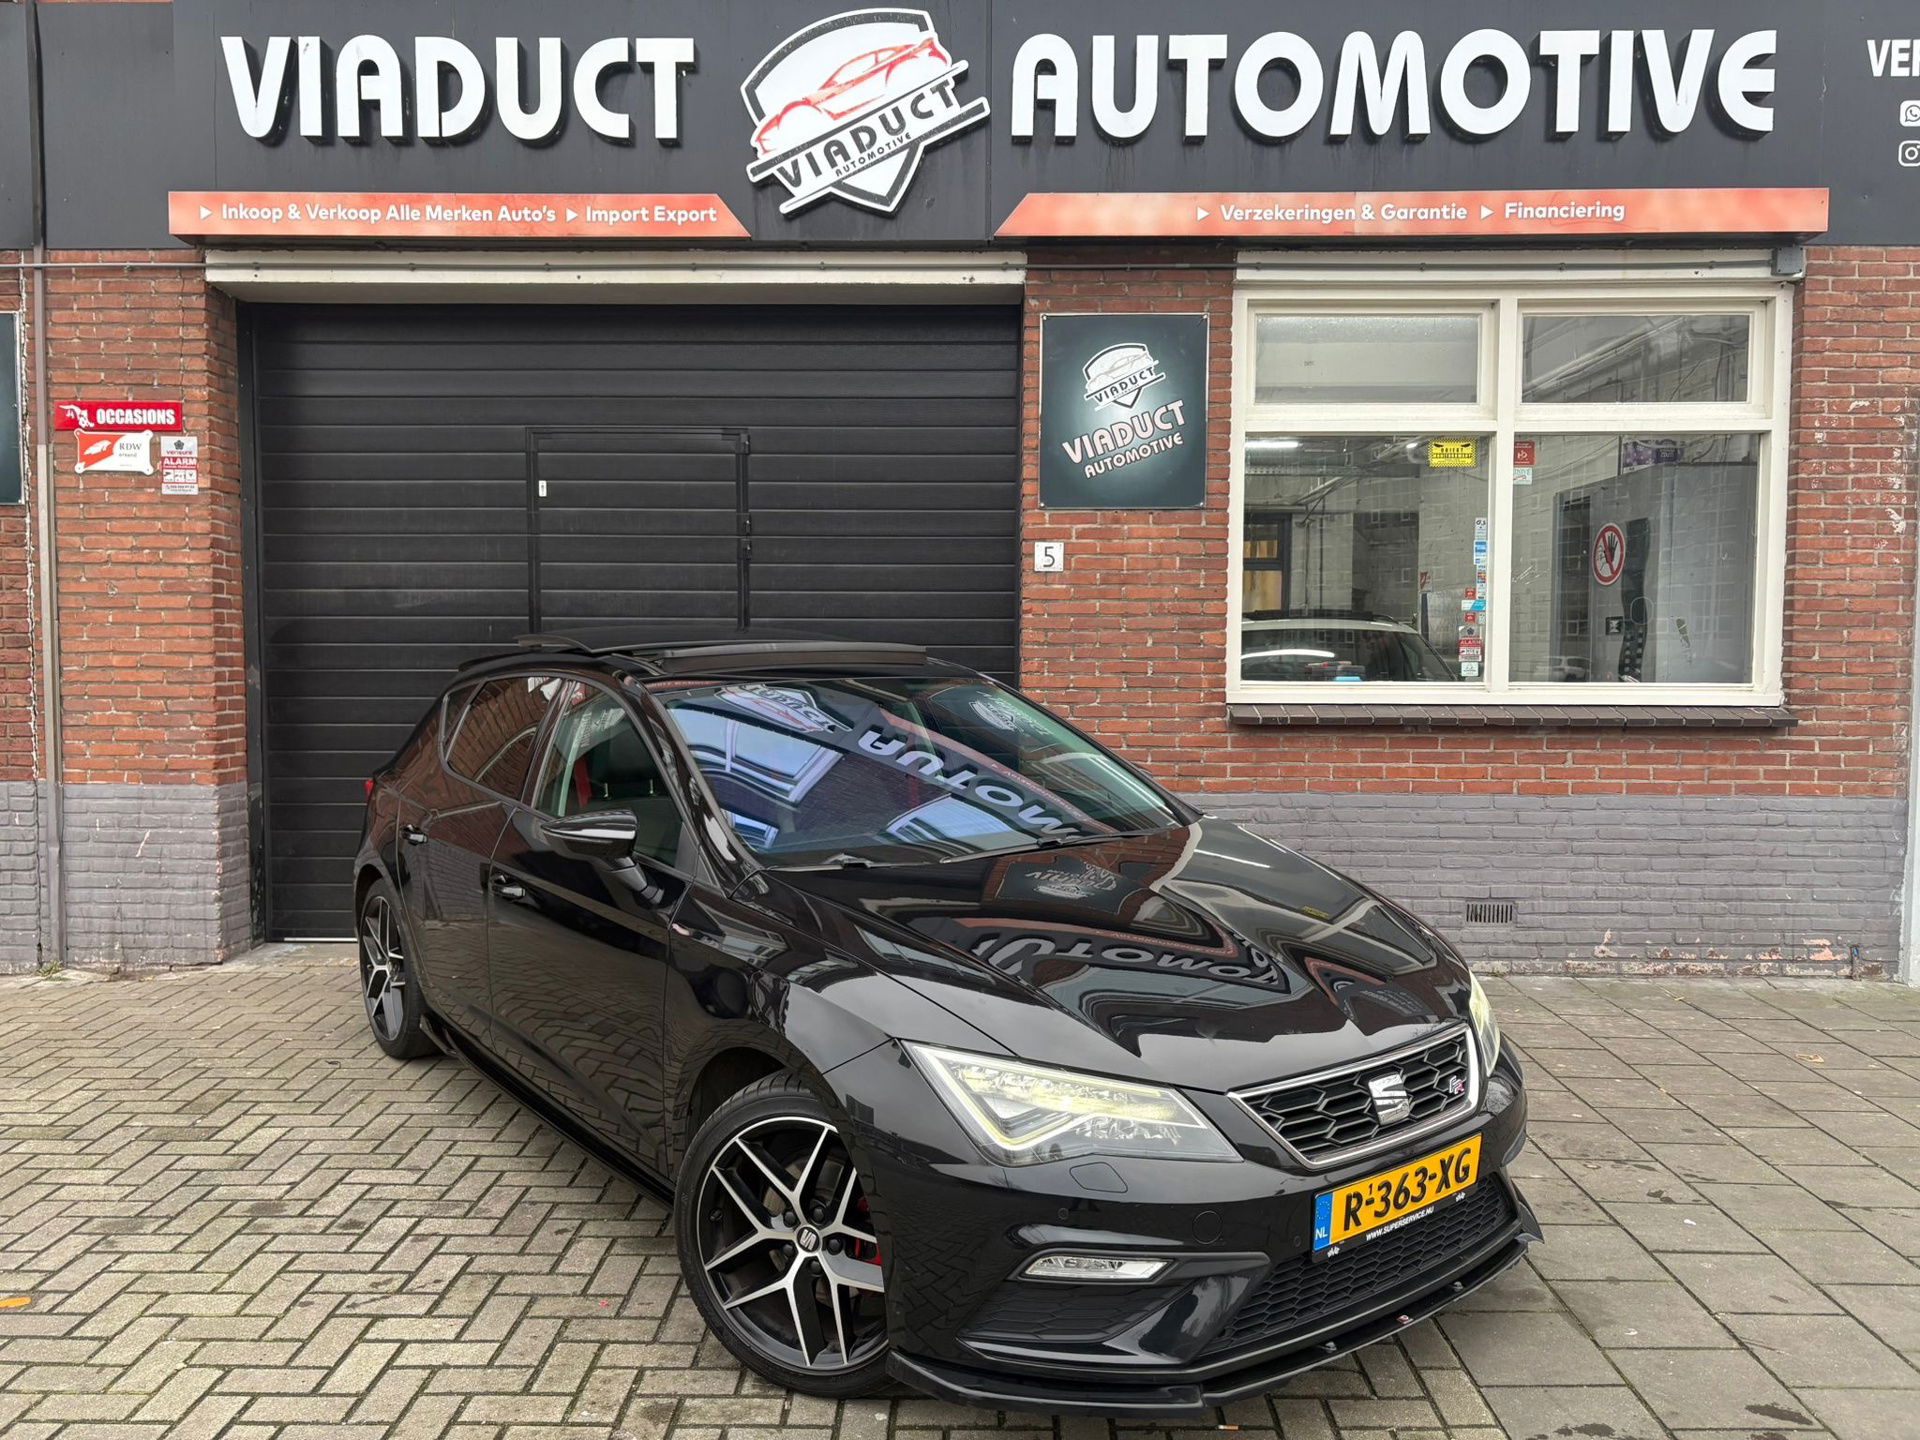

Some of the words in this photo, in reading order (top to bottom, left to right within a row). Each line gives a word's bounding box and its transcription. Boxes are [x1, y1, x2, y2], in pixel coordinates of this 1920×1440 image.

[221, 35, 694, 139] VIADUCT
[1011, 29, 1777, 137] AUTOMOTIVE
[776, 79, 955, 188] VIADUCT
[835, 131, 912, 177] AUTOMOTIVE
[221, 203, 283, 224] Inkoop
[287, 203, 302, 220] &
[305, 203, 382, 225] Verkoop
[386, 204, 422, 221] Alle
[426, 204, 493, 222] Merken
[497, 205, 557, 222] Auto's
[586, 206, 650, 226] Import
[654, 206, 717, 226] Export
[1220, 202, 1357, 223] Verzekeringen
[1360, 203, 1376, 220] &
[1380, 202, 1468, 221] Garantie
[1504, 201, 1625, 222] Financiering
[1094, 367, 1154, 402] VIADUCT
[96, 408, 176, 425] OCCASIONS
[119, 442, 141, 450] RDW
[1062, 400, 1186, 465] VIADUCT
[163, 457, 197, 466] ALARM
[1084, 432, 1184, 479] AUTOMOTIVE
[1043, 546, 1055, 568] 5
[1314, 1227, 1329, 1241] NL
[1343, 1147, 1472, 1232] R-363-XG
